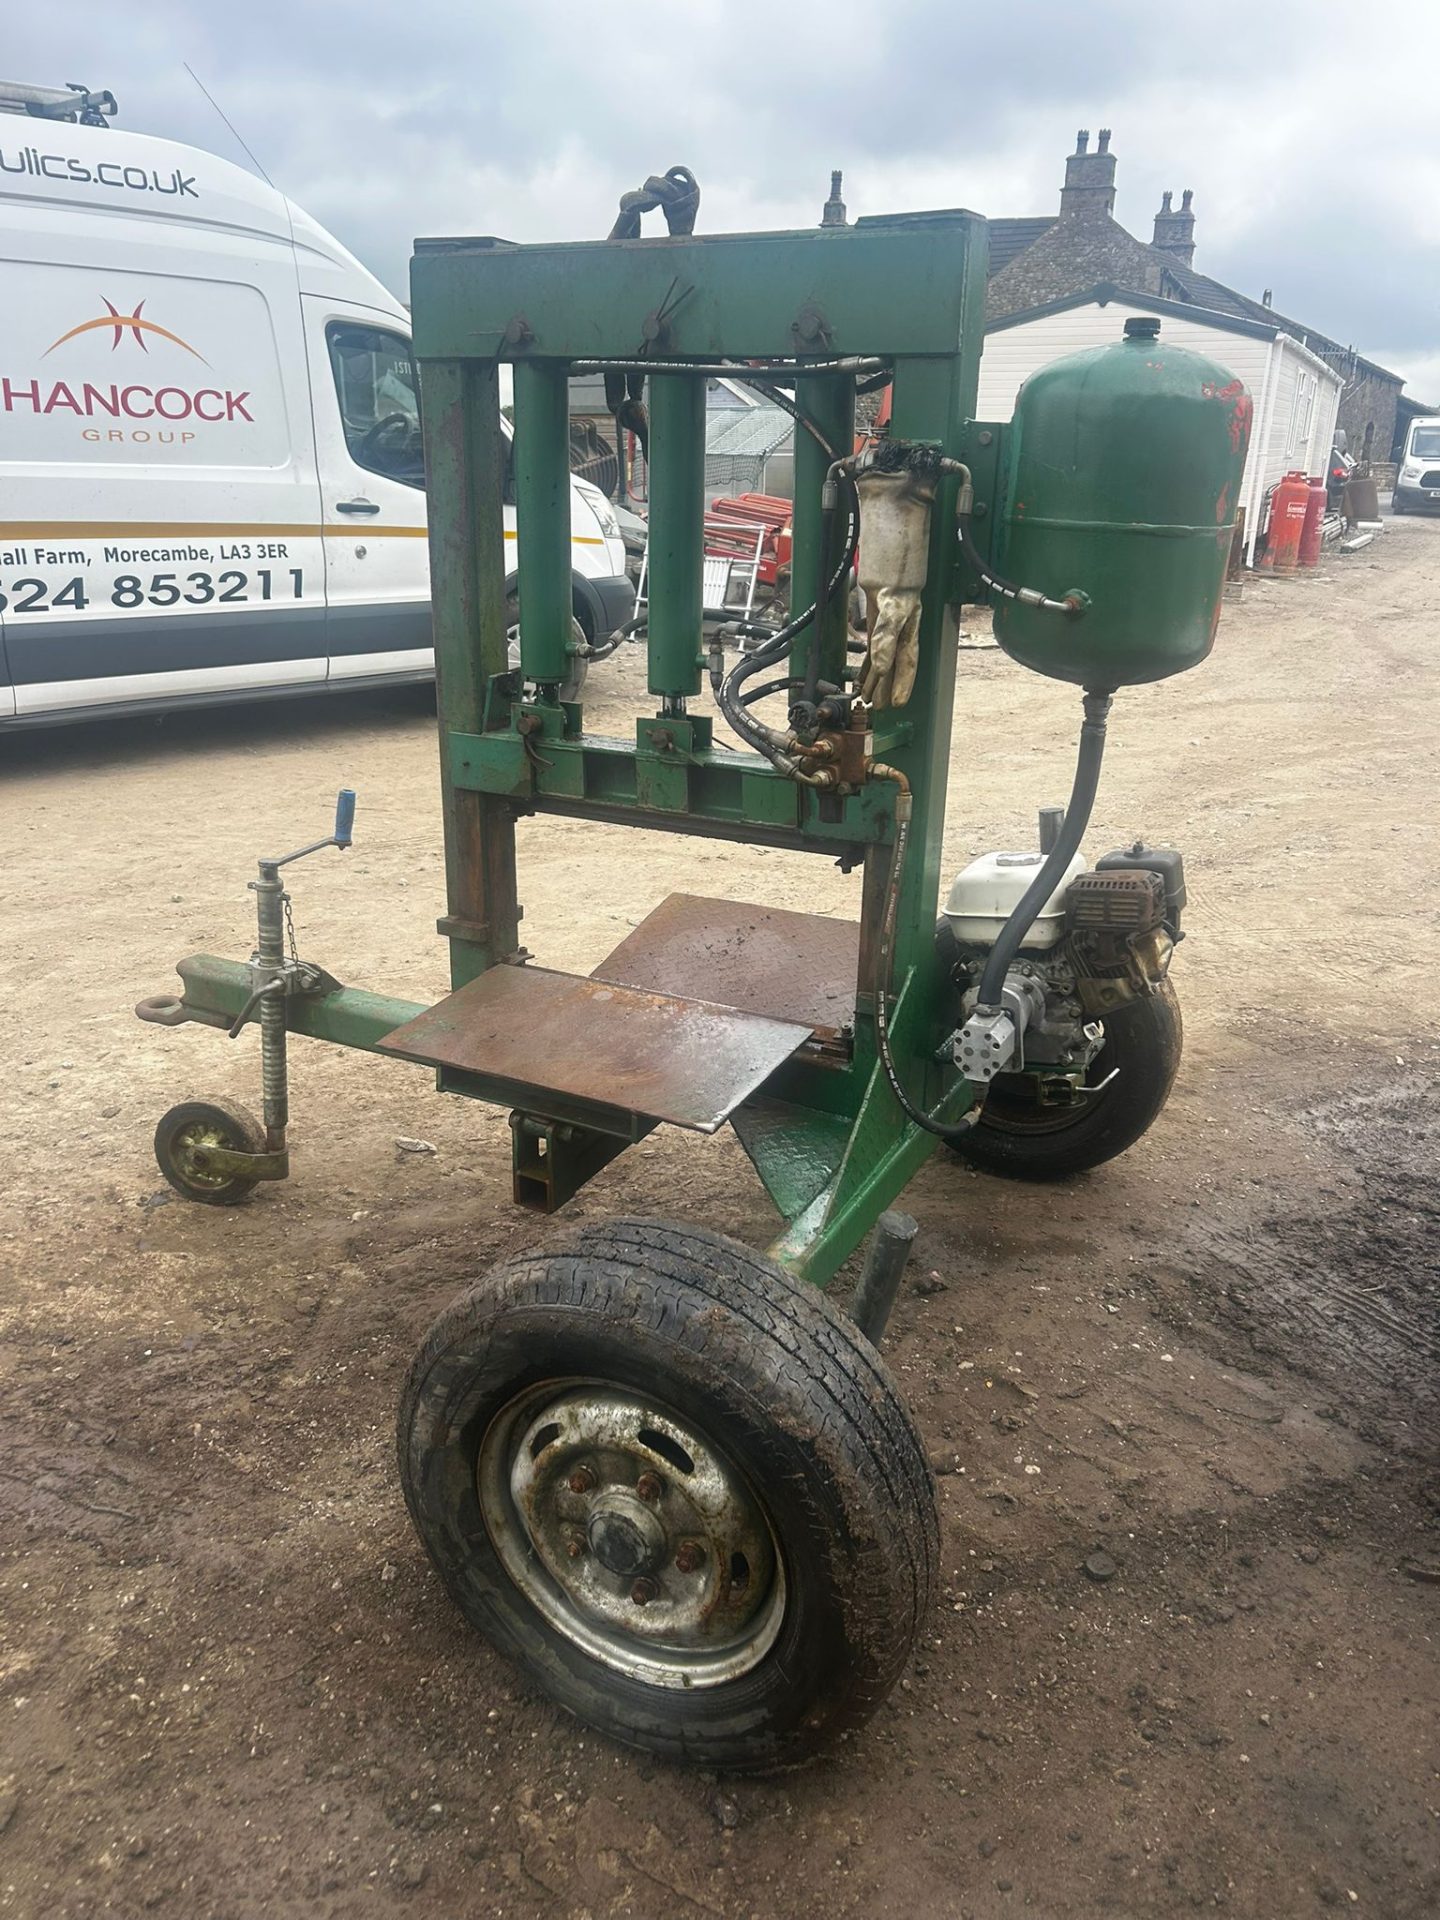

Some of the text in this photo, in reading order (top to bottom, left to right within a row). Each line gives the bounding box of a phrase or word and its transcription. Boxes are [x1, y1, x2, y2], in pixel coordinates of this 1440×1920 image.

[1, 377, 255, 422] HANCOCK
[81, 428, 196, 443] GROUP
[0, 543, 289, 567] all Farm, Morecambe, LA3 3ER
[111, 568, 303, 609] 853211
